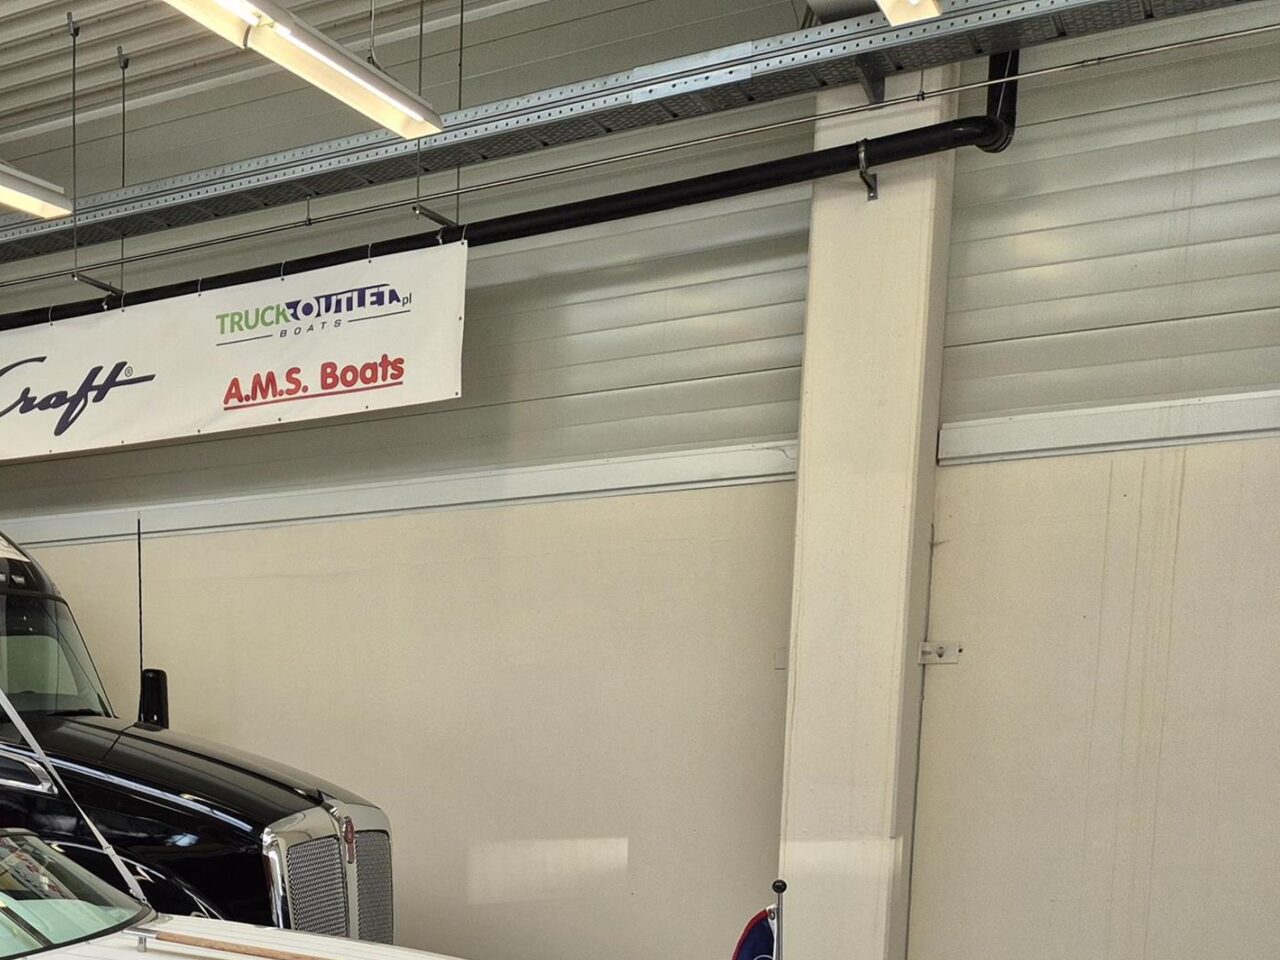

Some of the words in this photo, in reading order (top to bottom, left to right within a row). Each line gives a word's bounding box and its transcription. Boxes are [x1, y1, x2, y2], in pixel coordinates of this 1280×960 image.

[279, 319, 342, 338] BOATS
[223, 366, 309, 406] A.M.S.
[320, 353, 405, 390] Boats
